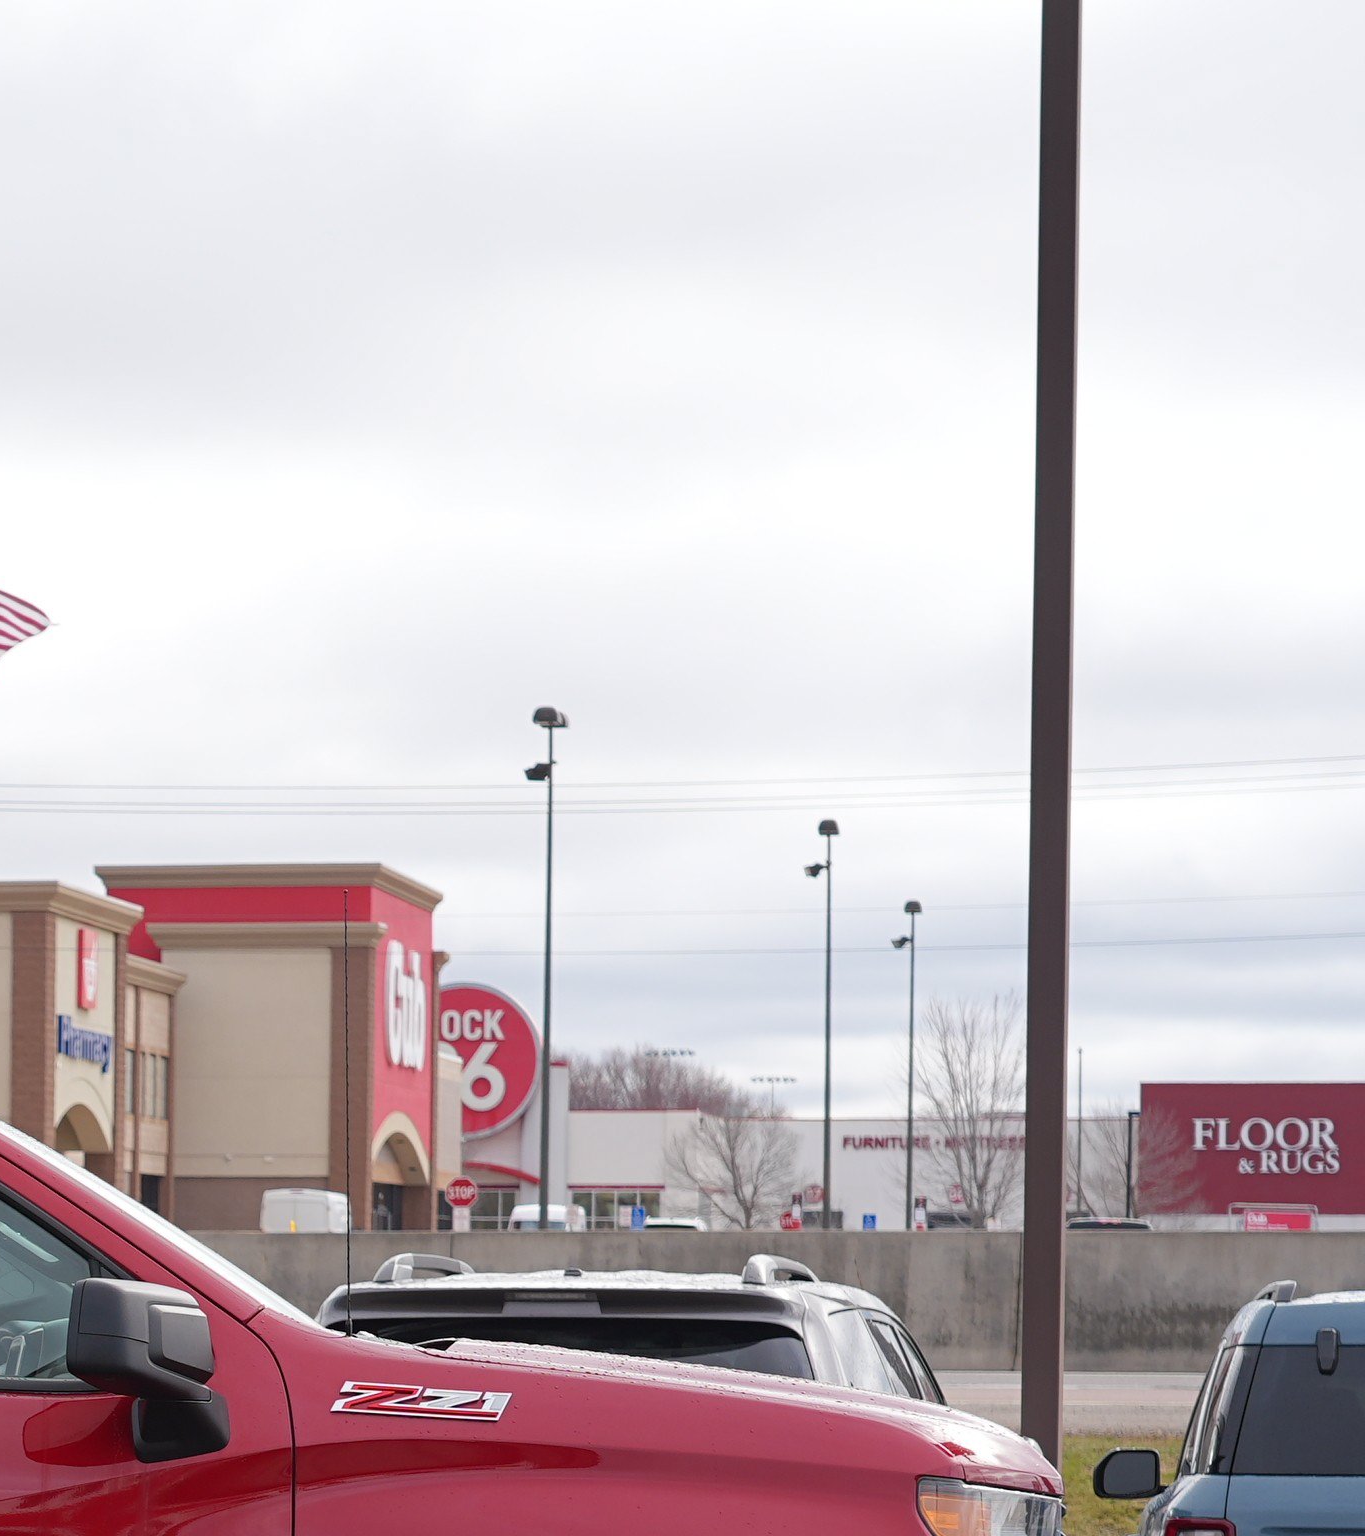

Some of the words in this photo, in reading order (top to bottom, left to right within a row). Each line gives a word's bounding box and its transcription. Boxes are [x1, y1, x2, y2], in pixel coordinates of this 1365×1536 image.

[385, 939, 427, 1071] Cub
[439, 1009, 505, 1041] OCK
[437, 1041, 506, 1112] 6
[842, 1135, 930, 1150] FURNITURE
[1192, 1117, 1339, 1151] FLOOR
[1238, 1157, 1255, 1174] &
[1259, 1150, 1340, 1174] RUGS
[448, 1185, 475, 1200] STOP
[330, 1380, 513, 1421] Z71
